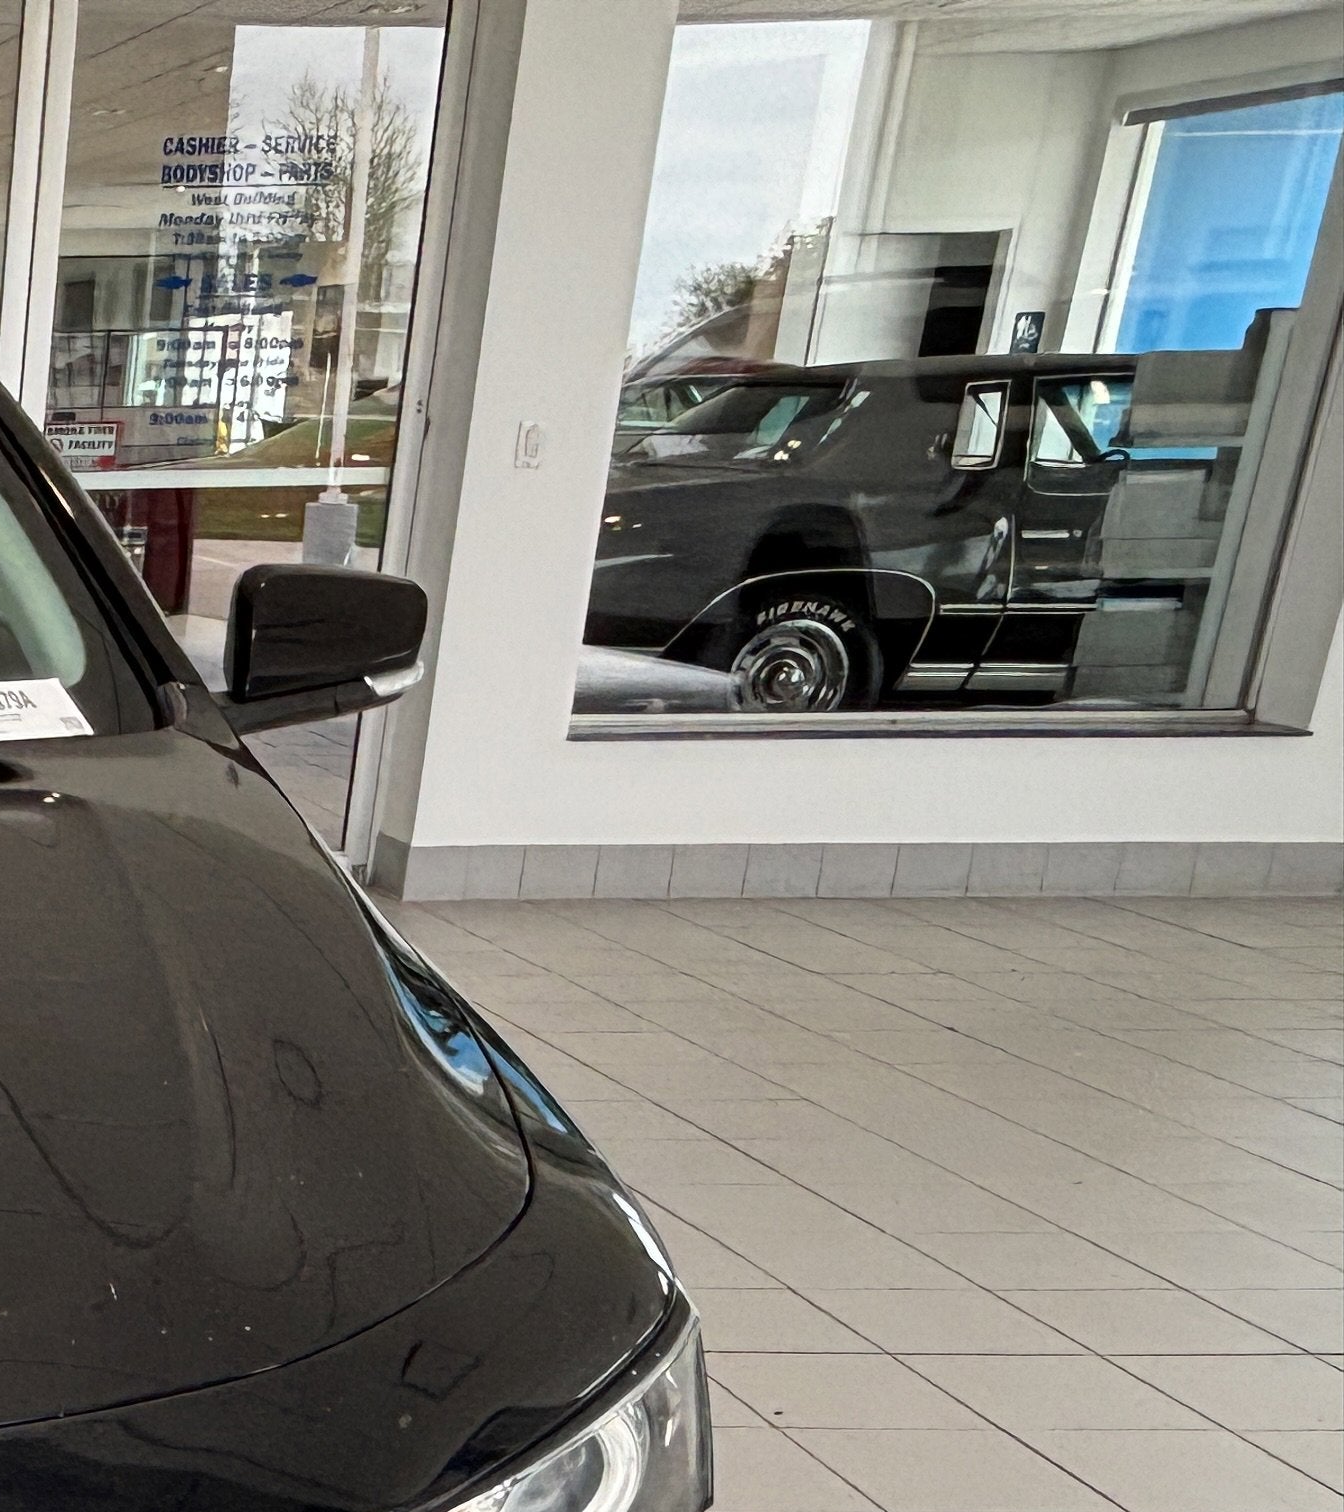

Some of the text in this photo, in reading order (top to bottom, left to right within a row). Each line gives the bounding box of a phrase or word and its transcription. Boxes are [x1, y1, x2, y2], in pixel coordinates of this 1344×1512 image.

[163, 136, 240, 157] CASHIER
[262, 134, 338, 154] SERVICE
[161, 163, 256, 184] BODYSHOP
[278, 162, 334, 182] PARTS
[159, 212, 224, 228] Monday
